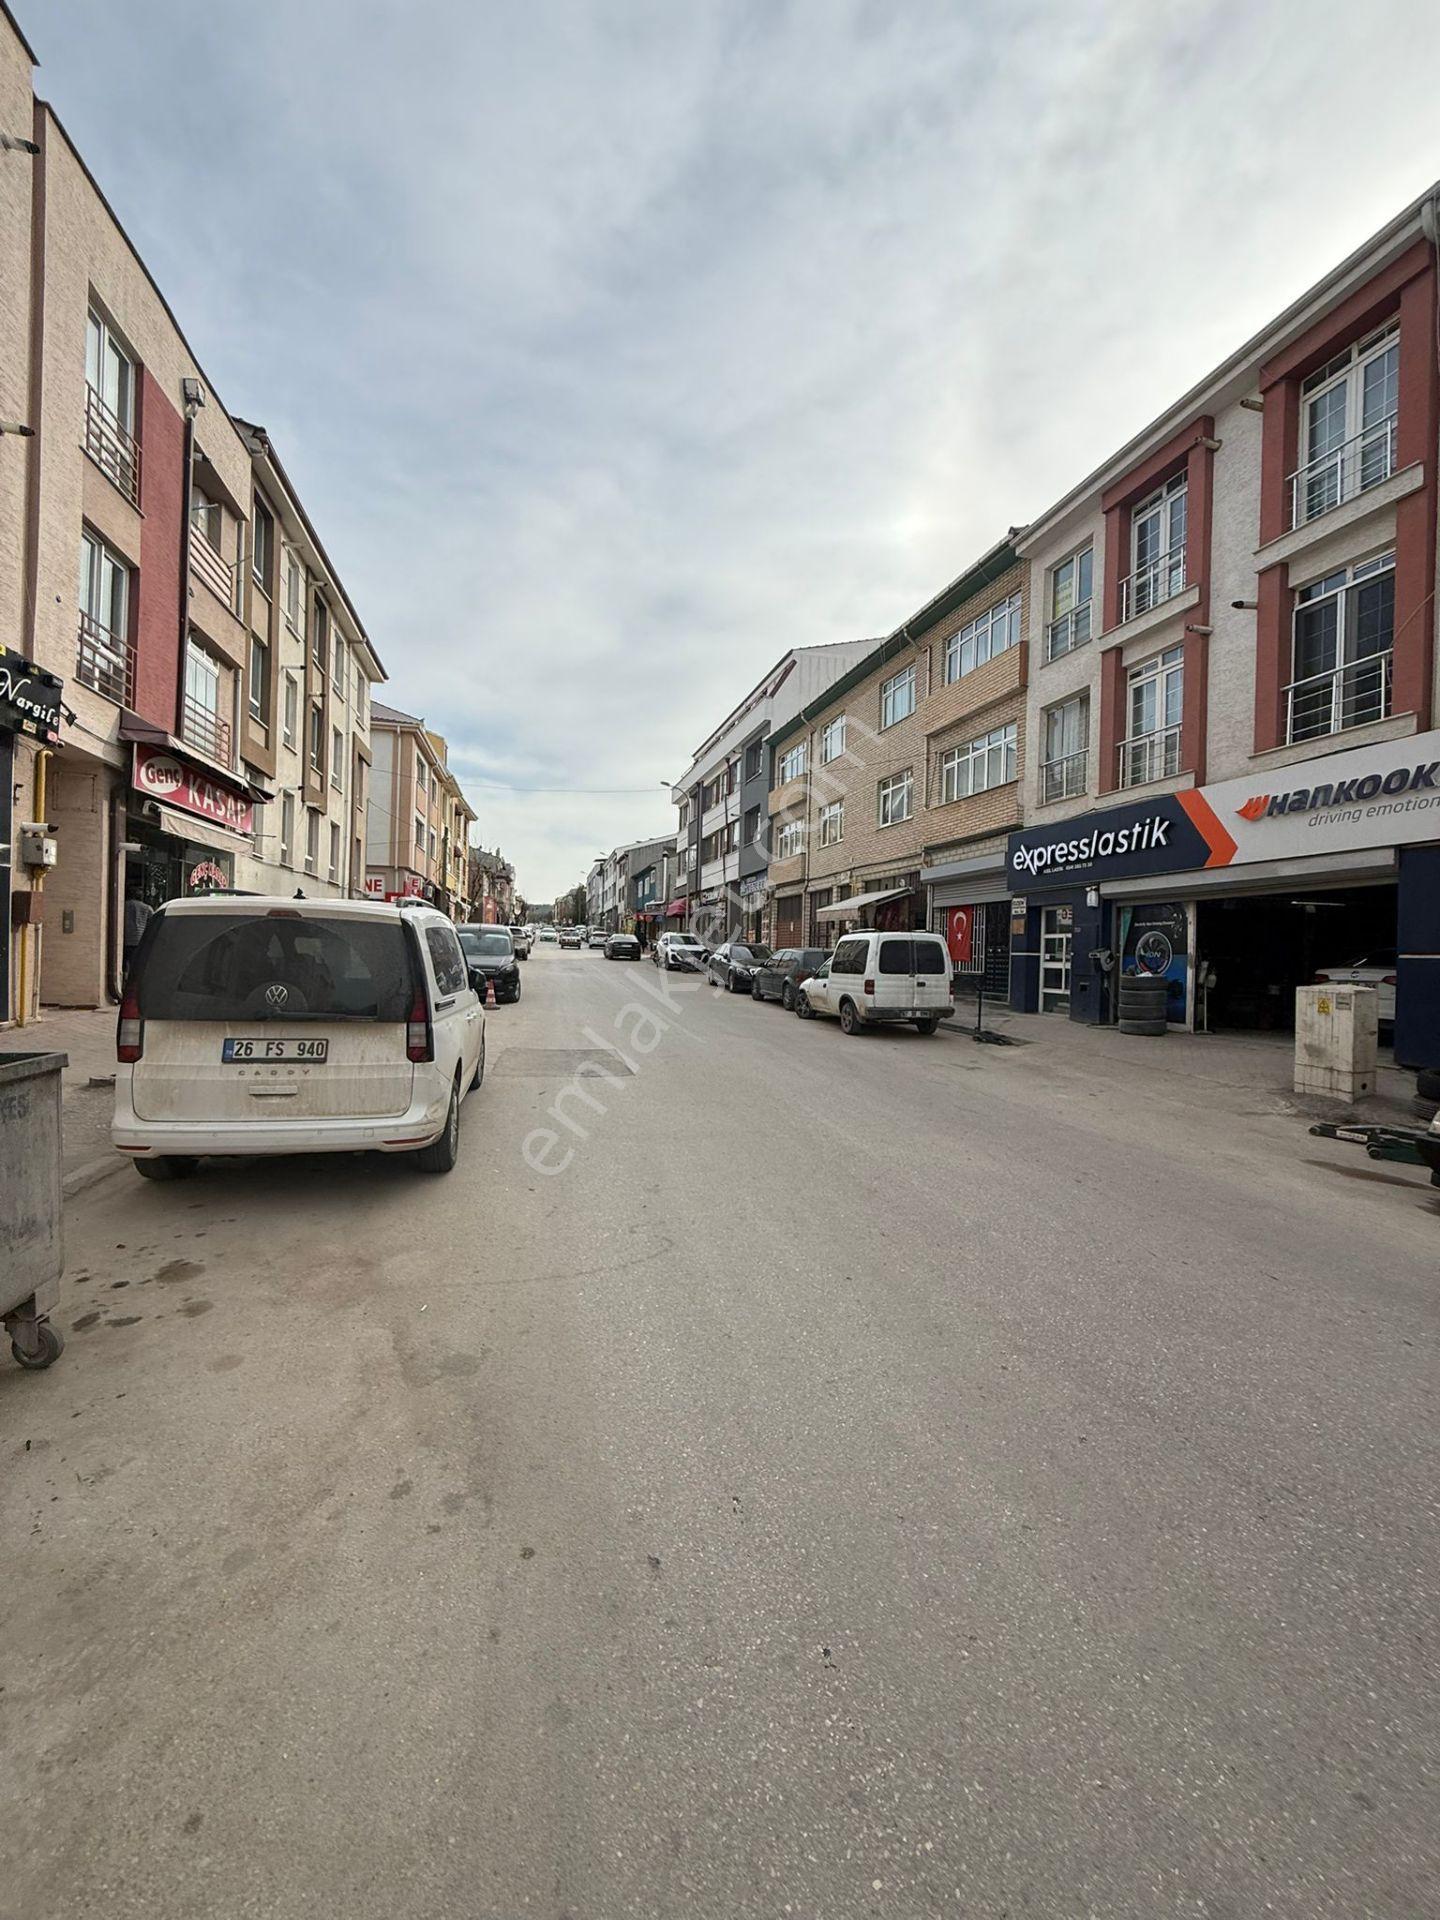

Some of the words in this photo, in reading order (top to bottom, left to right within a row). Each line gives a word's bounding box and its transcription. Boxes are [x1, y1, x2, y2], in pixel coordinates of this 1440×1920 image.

[145, 762, 181, 788] Genç
[188, 774, 246, 824] KASAP
[1308, 808, 1363, 827] driving
[1366, 796, 1440, 818] emotion
[234, 1042, 254, 1056] 26
[265, 1042, 285, 1056] FS
[297, 1042, 325, 1056] 940
